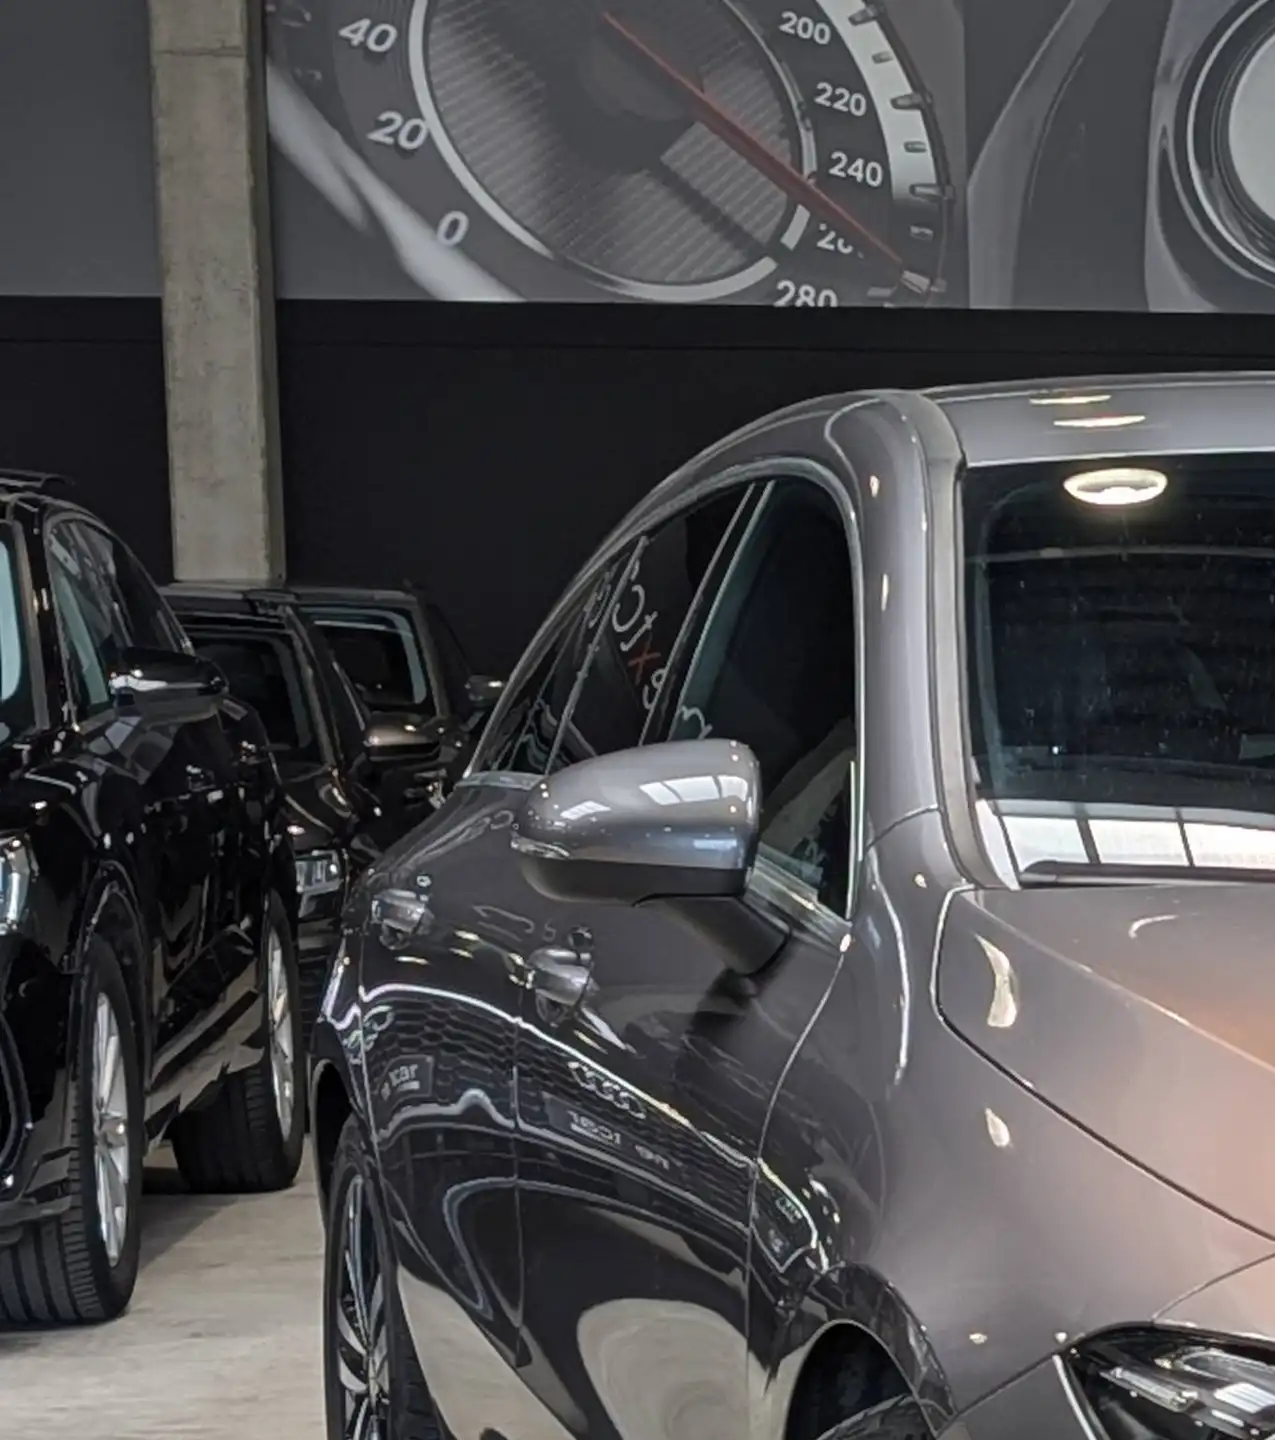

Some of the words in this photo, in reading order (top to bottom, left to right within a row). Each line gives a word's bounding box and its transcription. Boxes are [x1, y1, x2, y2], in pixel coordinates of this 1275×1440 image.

[338, 18, 397, 52] 40
[778, 11, 832, 45] 200
[813, 82, 867, 117] 220
[366, 110, 429, 150] 20
[828, 151, 883, 187] 240
[436, 210, 469, 246] 0
[773, 279, 838, 307] 280
